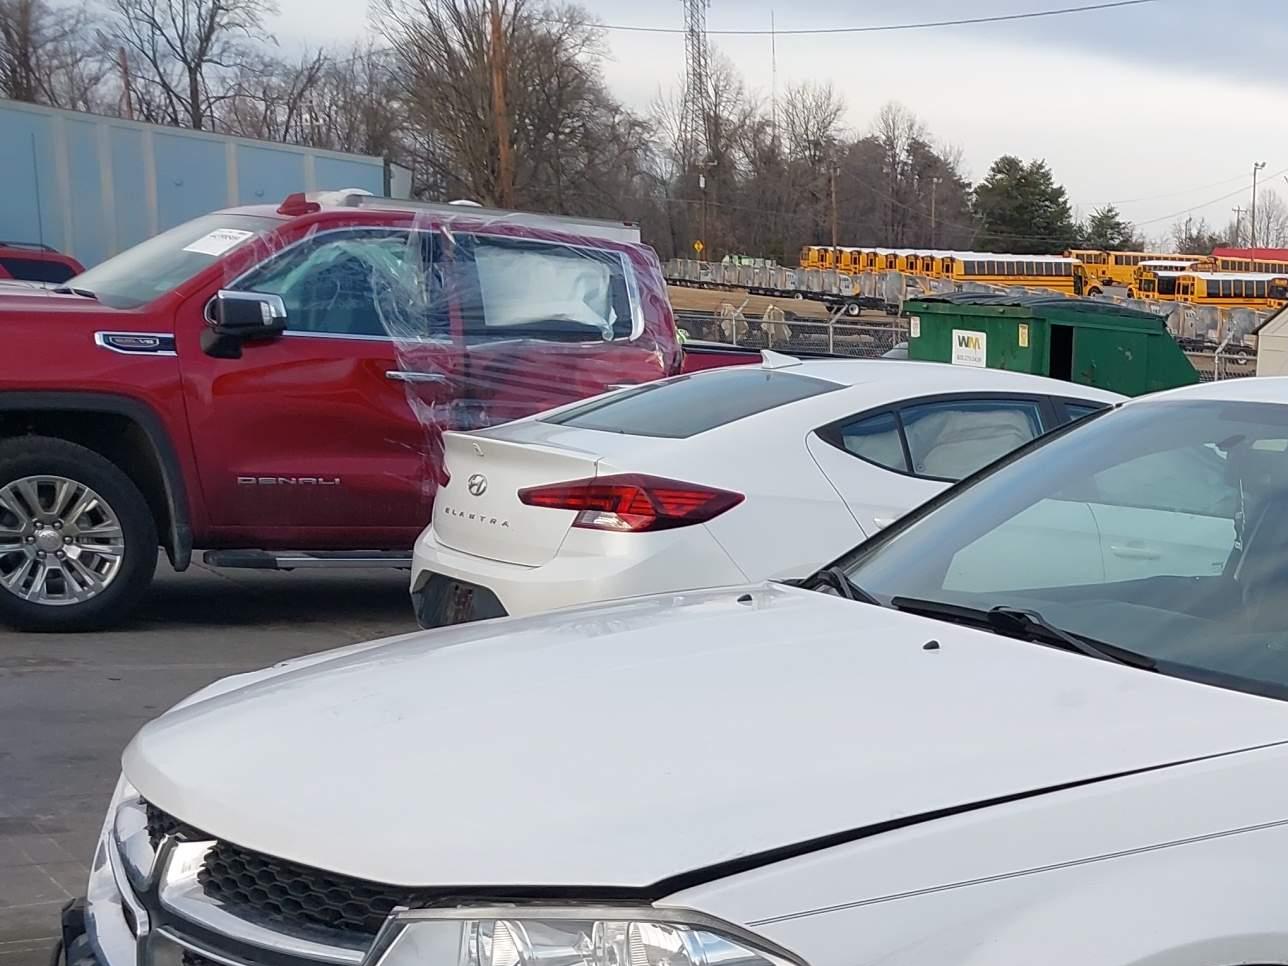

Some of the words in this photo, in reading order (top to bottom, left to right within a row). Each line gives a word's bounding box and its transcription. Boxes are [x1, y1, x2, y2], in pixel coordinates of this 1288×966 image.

[957, 334, 982, 350] WM
[237, 476, 340, 485] DENALI
[445, 507, 509, 528] ELANTRA
